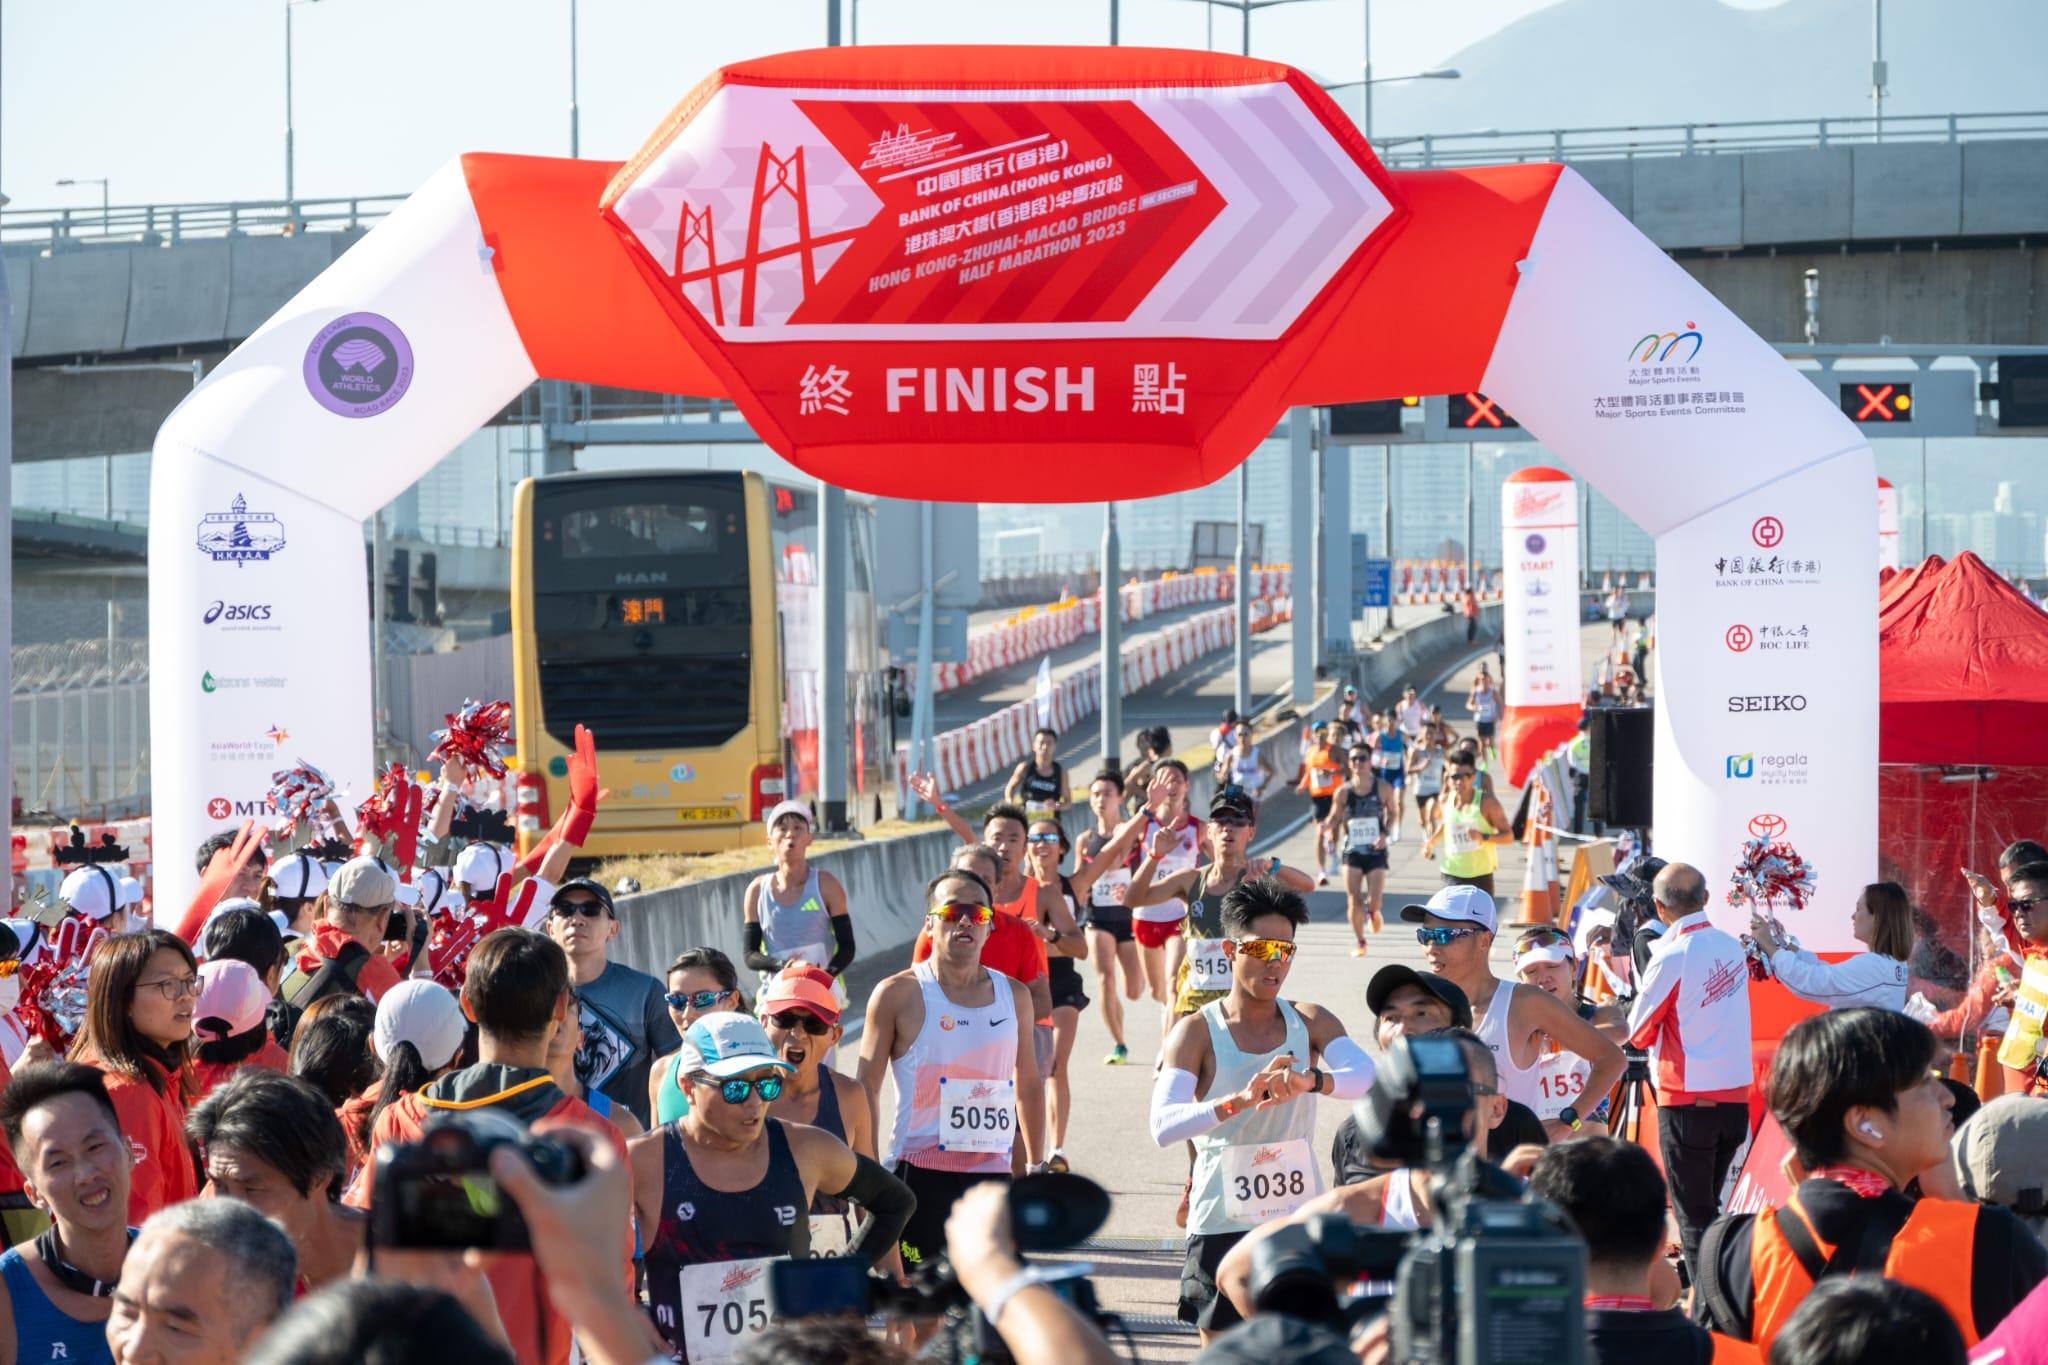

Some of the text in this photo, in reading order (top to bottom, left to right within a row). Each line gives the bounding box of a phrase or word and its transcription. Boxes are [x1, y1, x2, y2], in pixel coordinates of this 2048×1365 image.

[916, 139, 1069, 197] 中國銀行(香港)
[899, 204, 941, 228] BANK
[943, 198, 961, 215] OF
[1063, 154, 1113, 180] KONG)
[868, 267, 911, 293] HONG
[915, 219, 1078, 278] KONG-ZHUHAI-MACAO
[1081, 198, 1136, 228] BRIDGE
[1157, 183, 1196, 201] SECTION
[958, 220, 1127, 286] HALF MARATHON 2023
[332, 382, 382, 392] ATHLETICS
[340, 375, 374, 384] WORLD
[1629, 375, 1701, 386] Major Sports Events
[799, 362, 1187, 416] 終 FINISH 點
[1595, 406, 1746, 420] Major Sports Events Committee
[1755, 578, 1784, 586] CHINA
[1760, 641, 1810, 650] BOC LIFE
[1728, 695, 1807, 712] SEIKO
[1761, 752, 1807, 768] regala
[235, 801, 277, 816] MT
[1195, 958, 1232, 975] 515
[950, 1106, 1010, 1131] 5056
[1234, 1170, 1304, 1201] 3038
[697, 1299, 778, 1338] 705
